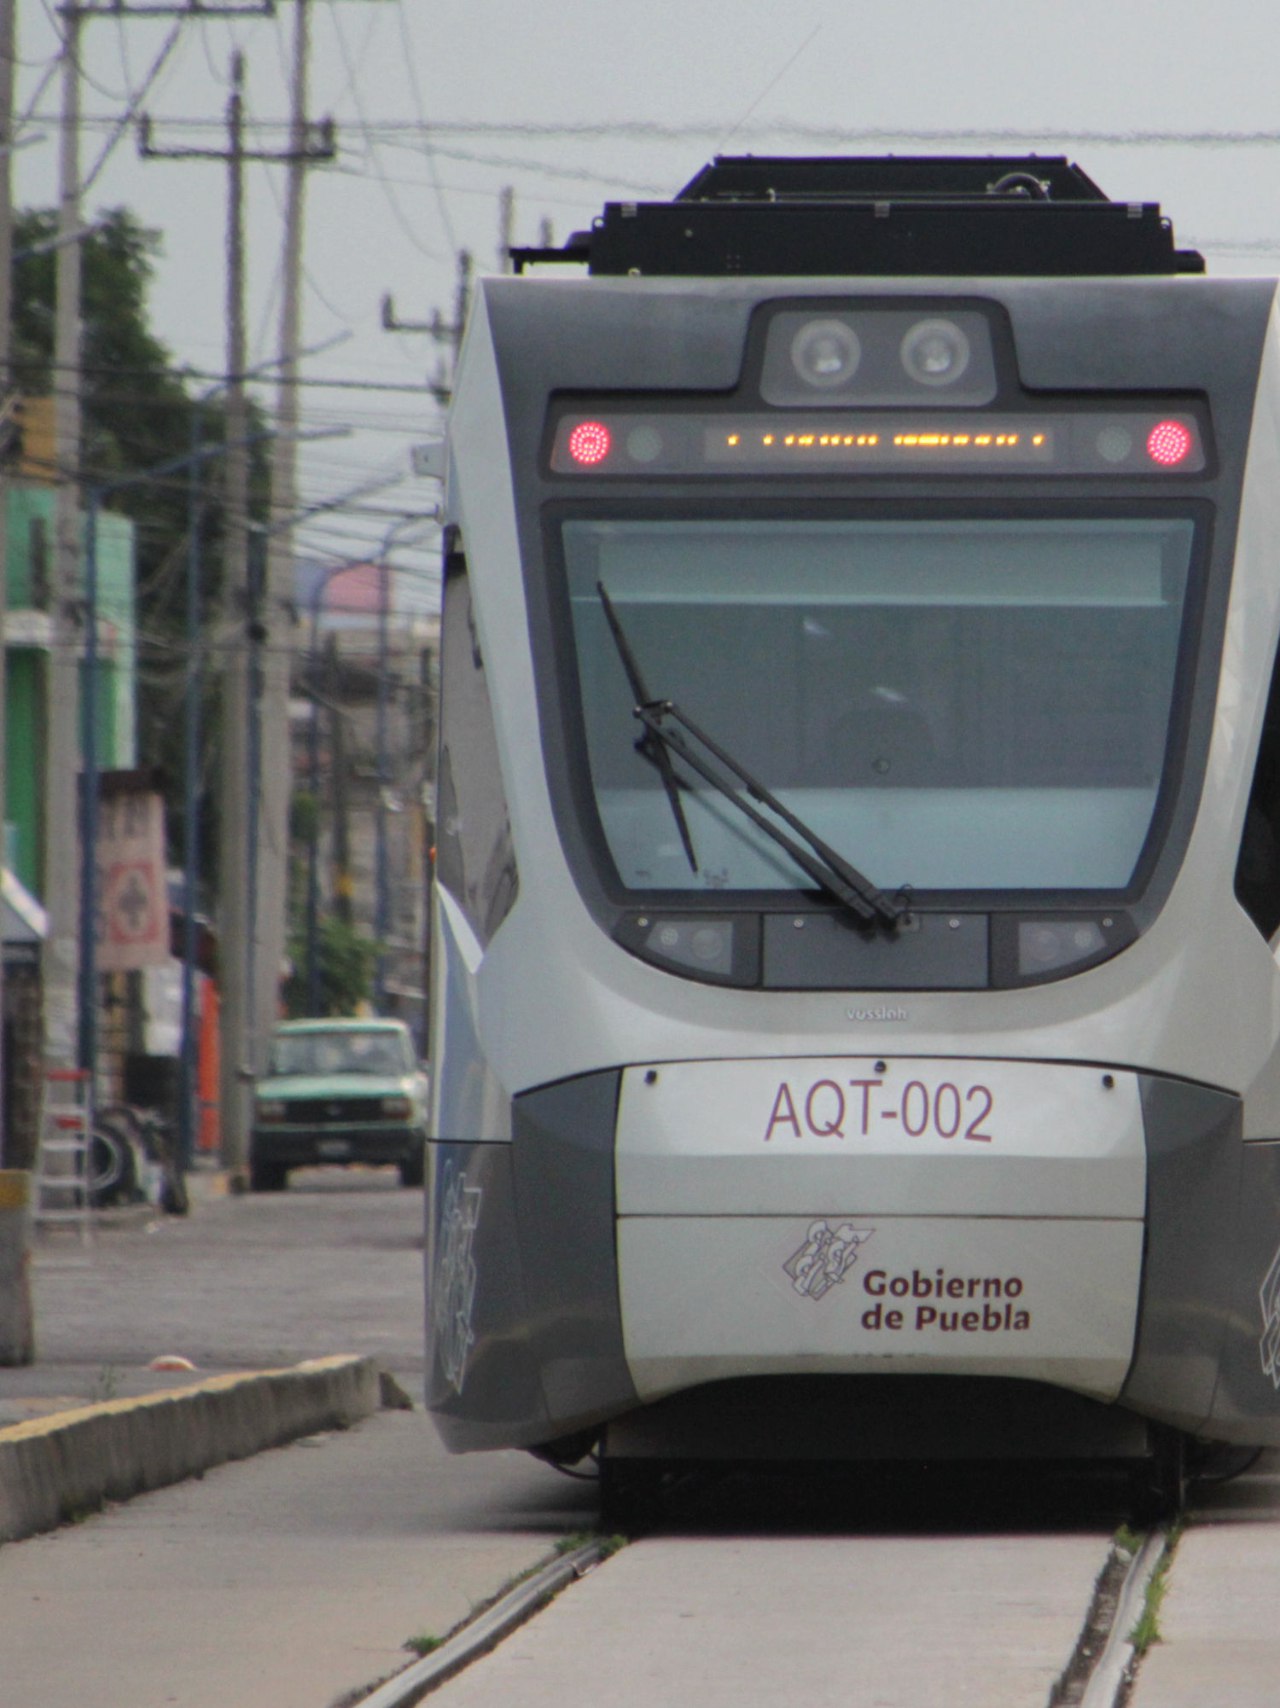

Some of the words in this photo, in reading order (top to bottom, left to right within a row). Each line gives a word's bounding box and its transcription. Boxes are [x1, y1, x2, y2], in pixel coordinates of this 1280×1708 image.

[763, 1079, 994, 1143] AQT-002
[862, 1268, 1024, 1300] Gobierno
[861, 1303, 904, 1332] de
[914, 1303, 1031, 1333] Puebla
